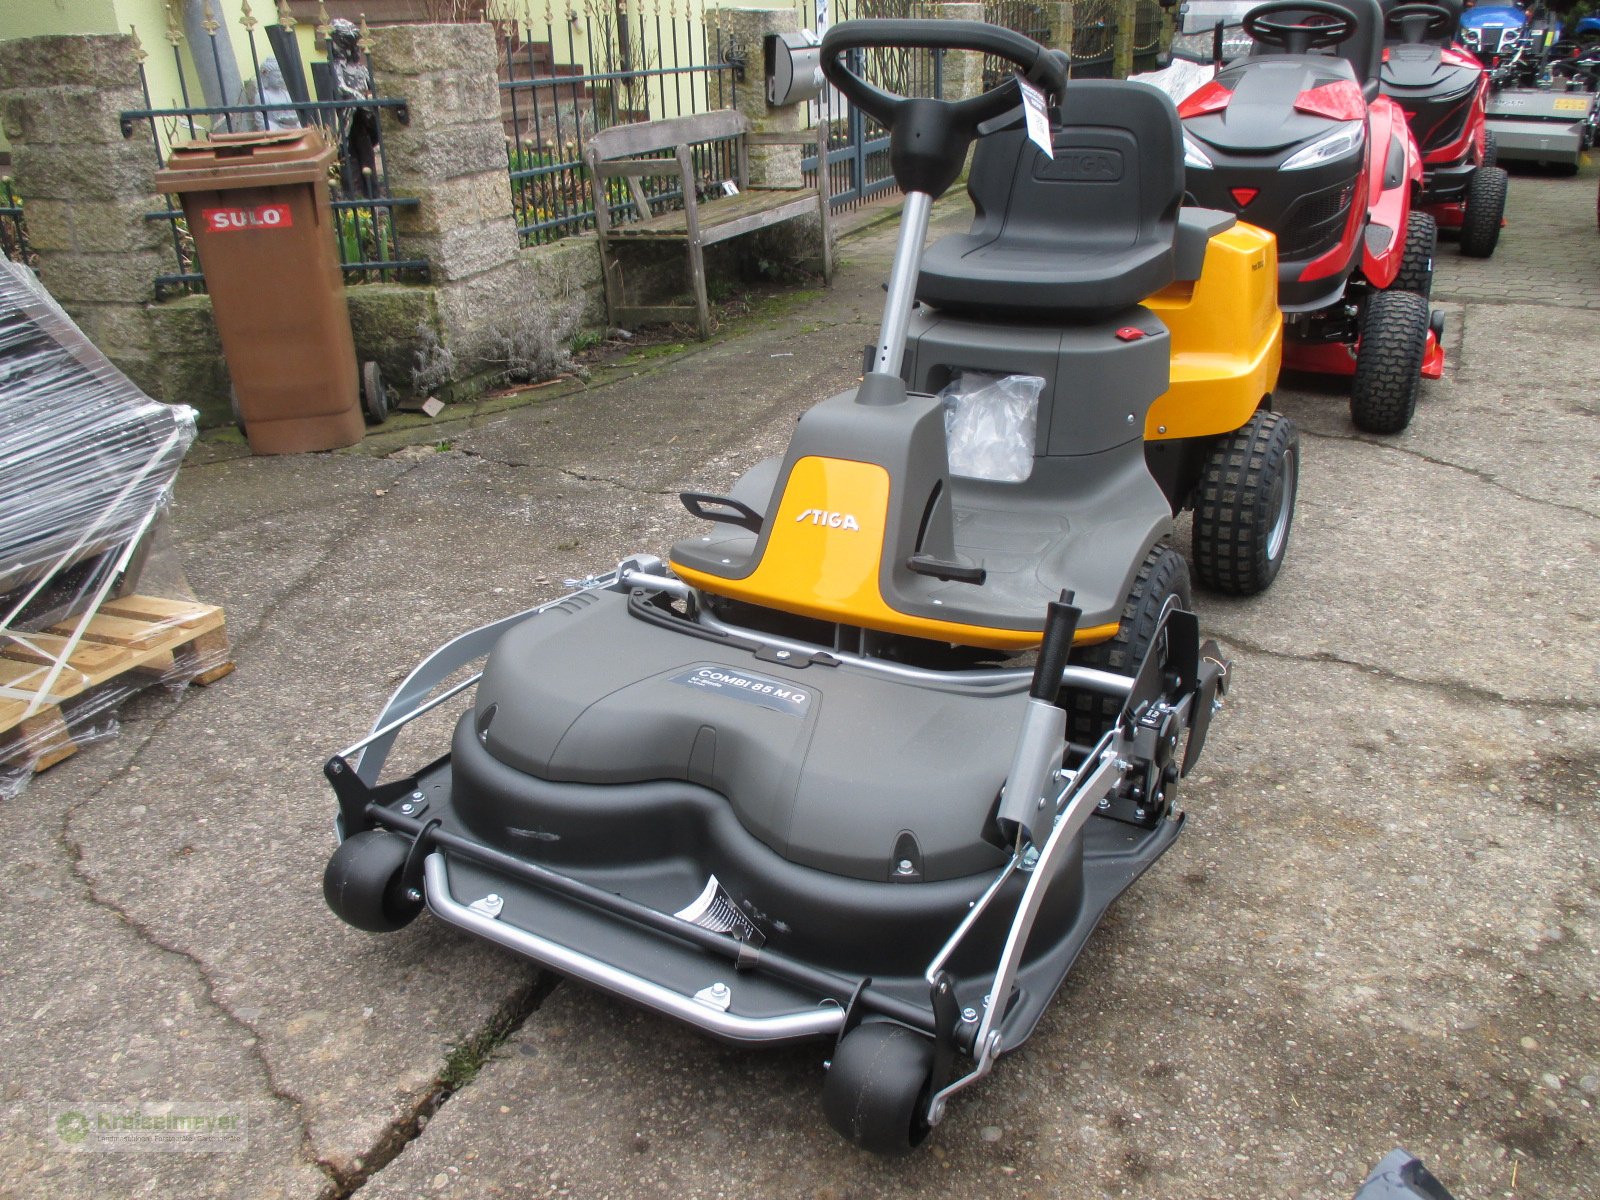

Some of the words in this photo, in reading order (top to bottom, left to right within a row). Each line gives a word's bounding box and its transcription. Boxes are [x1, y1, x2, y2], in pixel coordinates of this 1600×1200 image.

[213, 208, 281, 228] SULO
[796, 509, 859, 531] STIGA
[698, 669, 753, 688] COMBI
[751, 683, 774, 693] 85
[773, 689, 791, 698] M
[791, 694, 805, 704] Q
